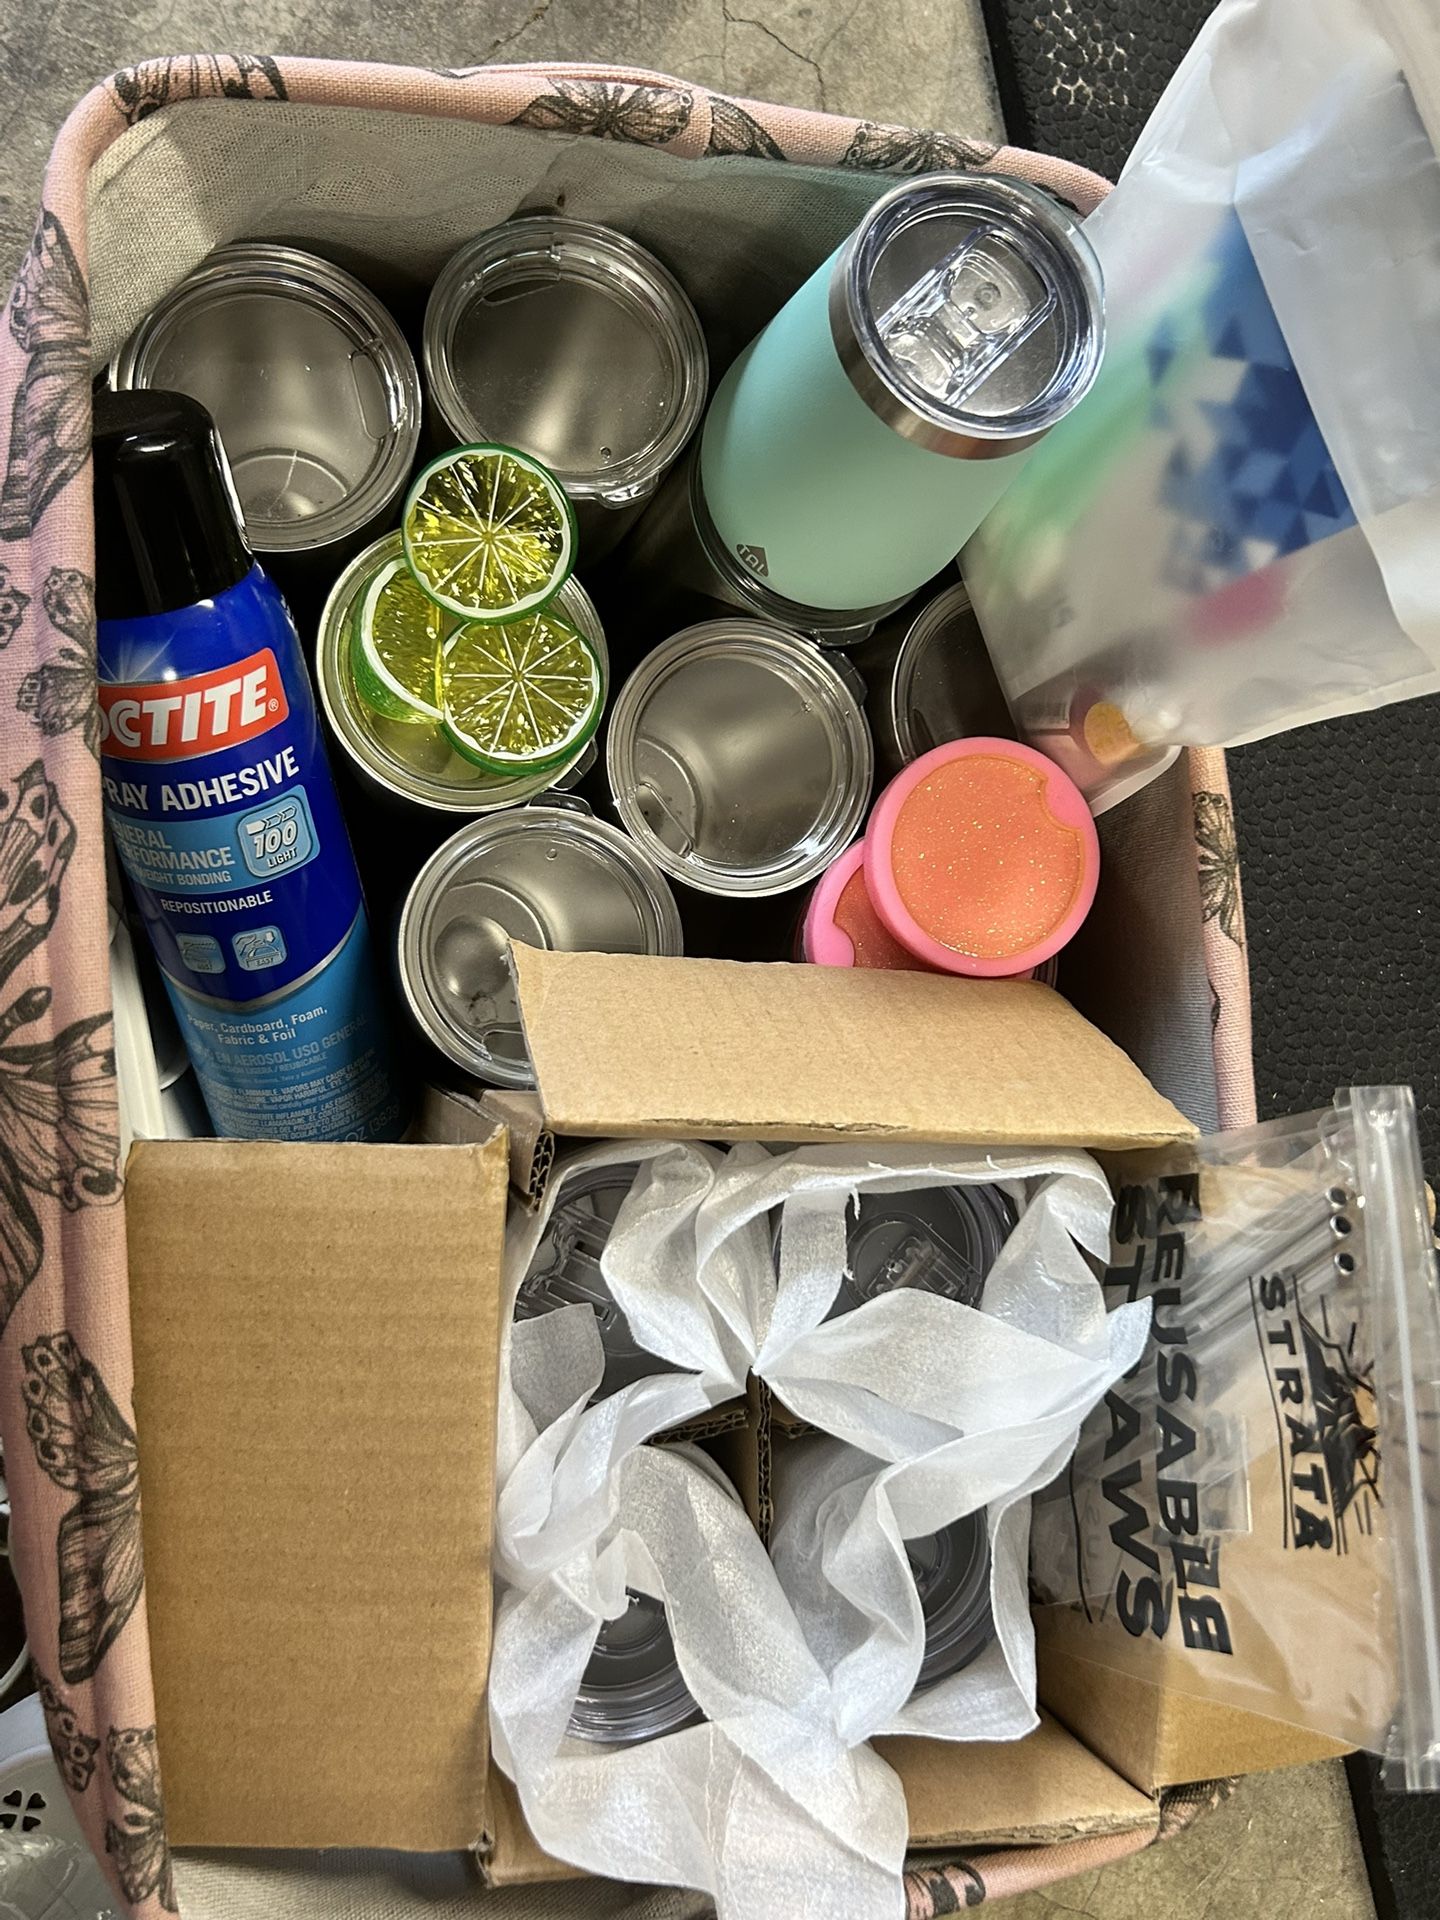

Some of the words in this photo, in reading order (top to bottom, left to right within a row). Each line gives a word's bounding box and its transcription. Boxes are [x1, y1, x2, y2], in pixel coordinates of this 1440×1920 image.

[740, 546, 765, 577] TAL
[102, 776, 149, 811] RAY
[161, 746, 300, 812] ADHESIVE
[254, 820, 298, 859] 100
[266, 847, 298, 868] LIGHT
[177, 870, 232, 885] BONDING
[160, 890, 273, 914] REPOSITIONABLE
[217, 1033, 255, 1045] Fabric
[258, 1033, 269, 1044] &
[272, 1028, 296, 1042] Foil
[220, 1018, 288, 1033] Cardboard,
[291, 1006, 328, 1025] Foam,
[234, 1050, 292, 1066] AEROSOL
[292, 1041, 320, 1060] USO
[321, 1015, 367, 1049] GENERAL
[1100, 1184, 1166, 1640] STAWS
[1150, 1173, 1234, 1656] REUSABLE
[1259, 1276, 1334, 1550] STRATA
